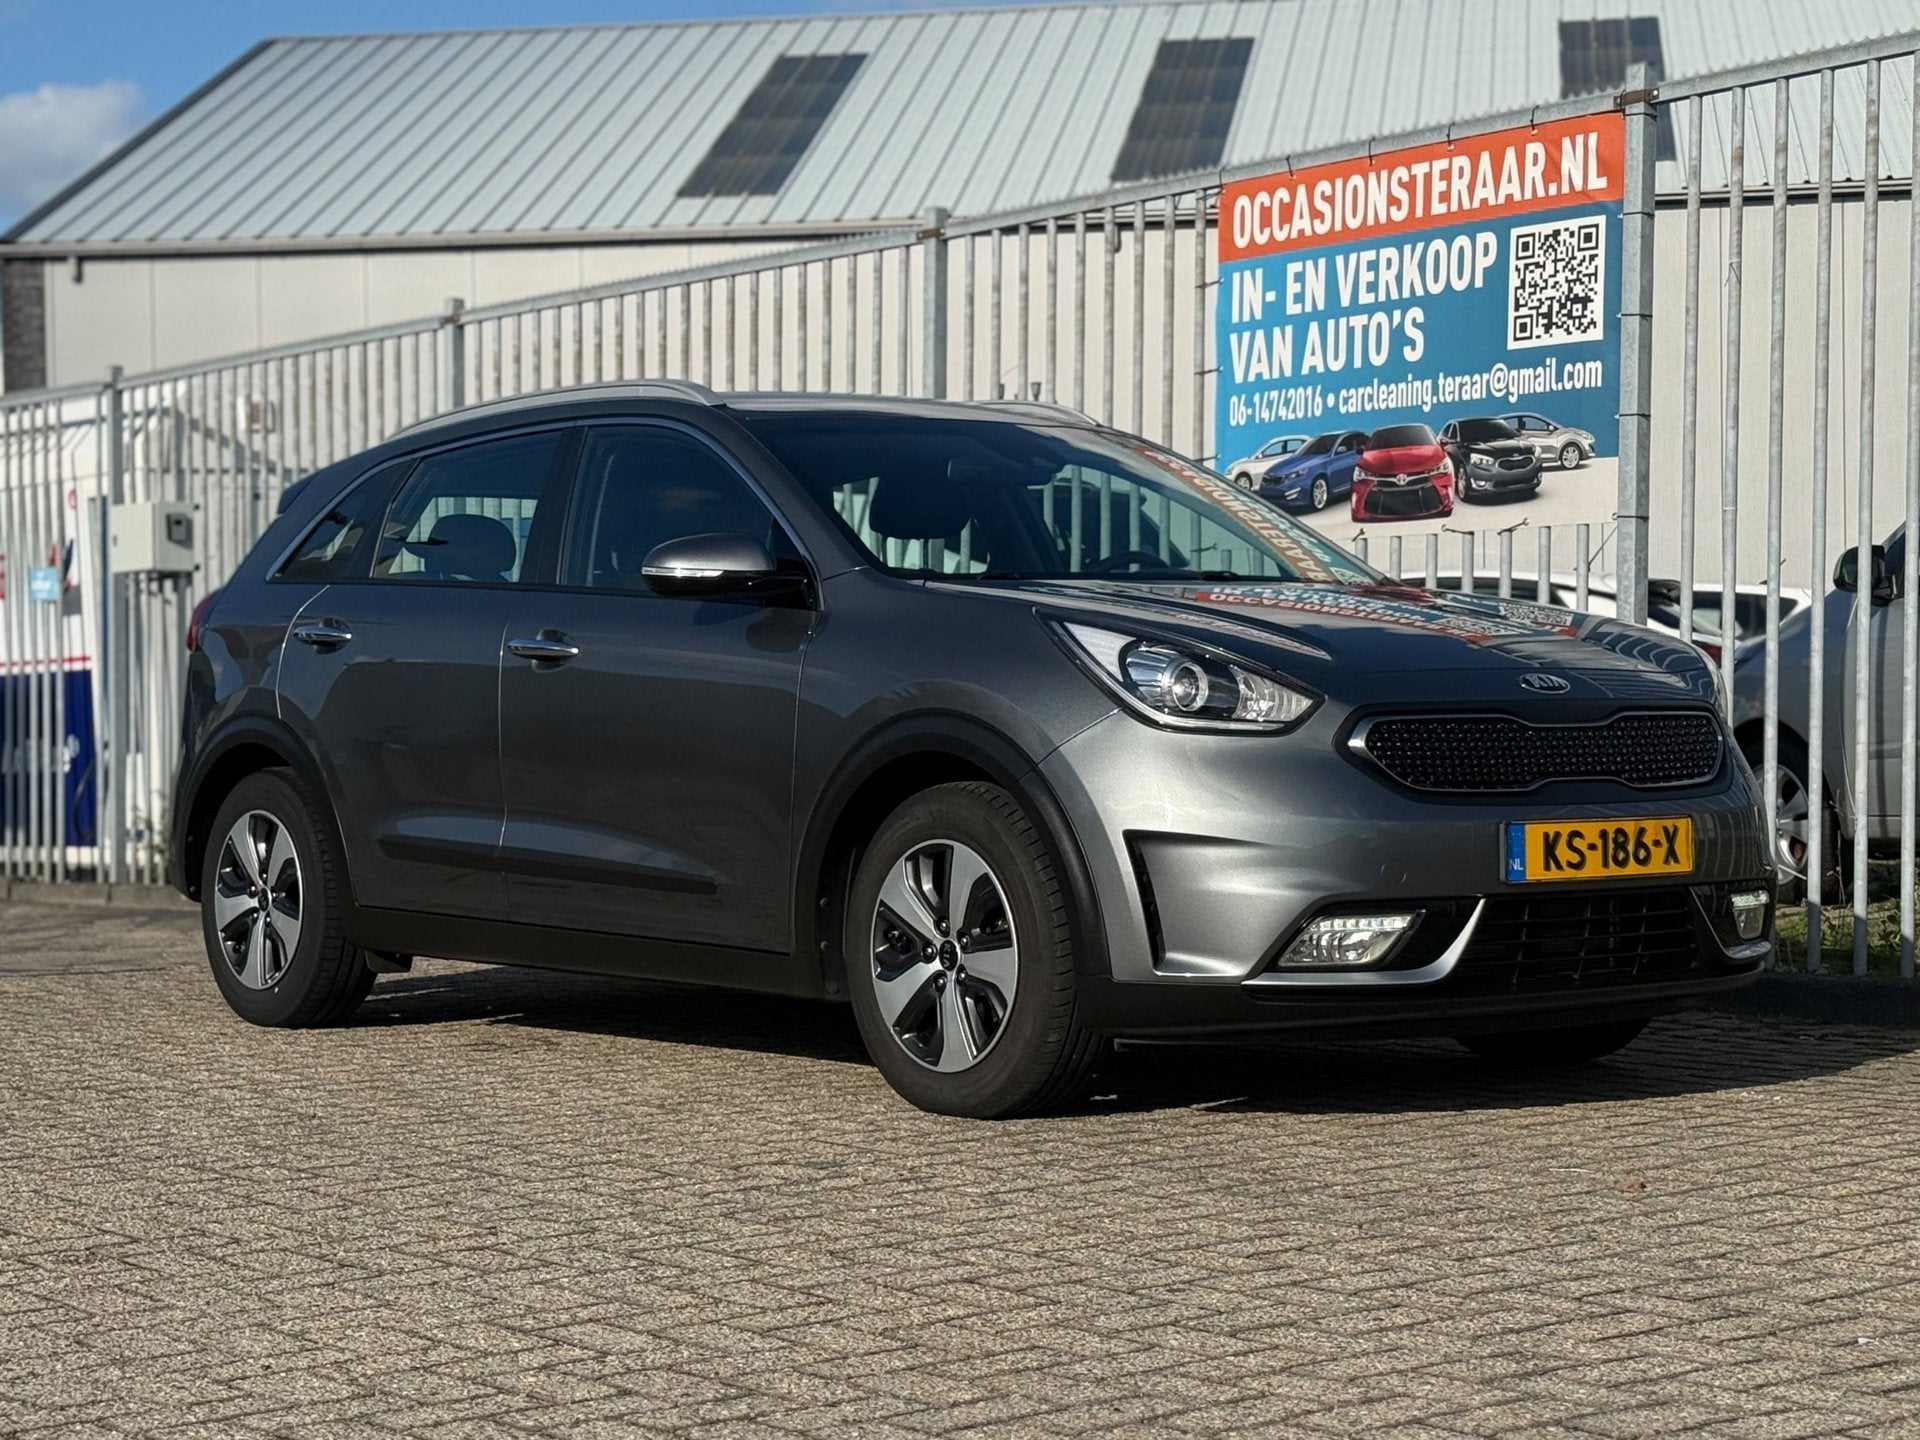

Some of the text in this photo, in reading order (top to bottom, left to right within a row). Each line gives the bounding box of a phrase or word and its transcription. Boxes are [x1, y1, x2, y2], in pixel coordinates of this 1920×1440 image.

[1233, 131, 1608, 249] OCCASIONSTERAAR.NL
[1231, 231, 1498, 324] IN- EN VERKOOP
[1229, 306, 1425, 384] VAN AUTO'S
[1229, 356, 1603, 427] 06-14742016 carcleaning.teraar@gmail.com
[1509, 858, 1524, 871] NL
[1542, 824, 1681, 872] KS-186-X
